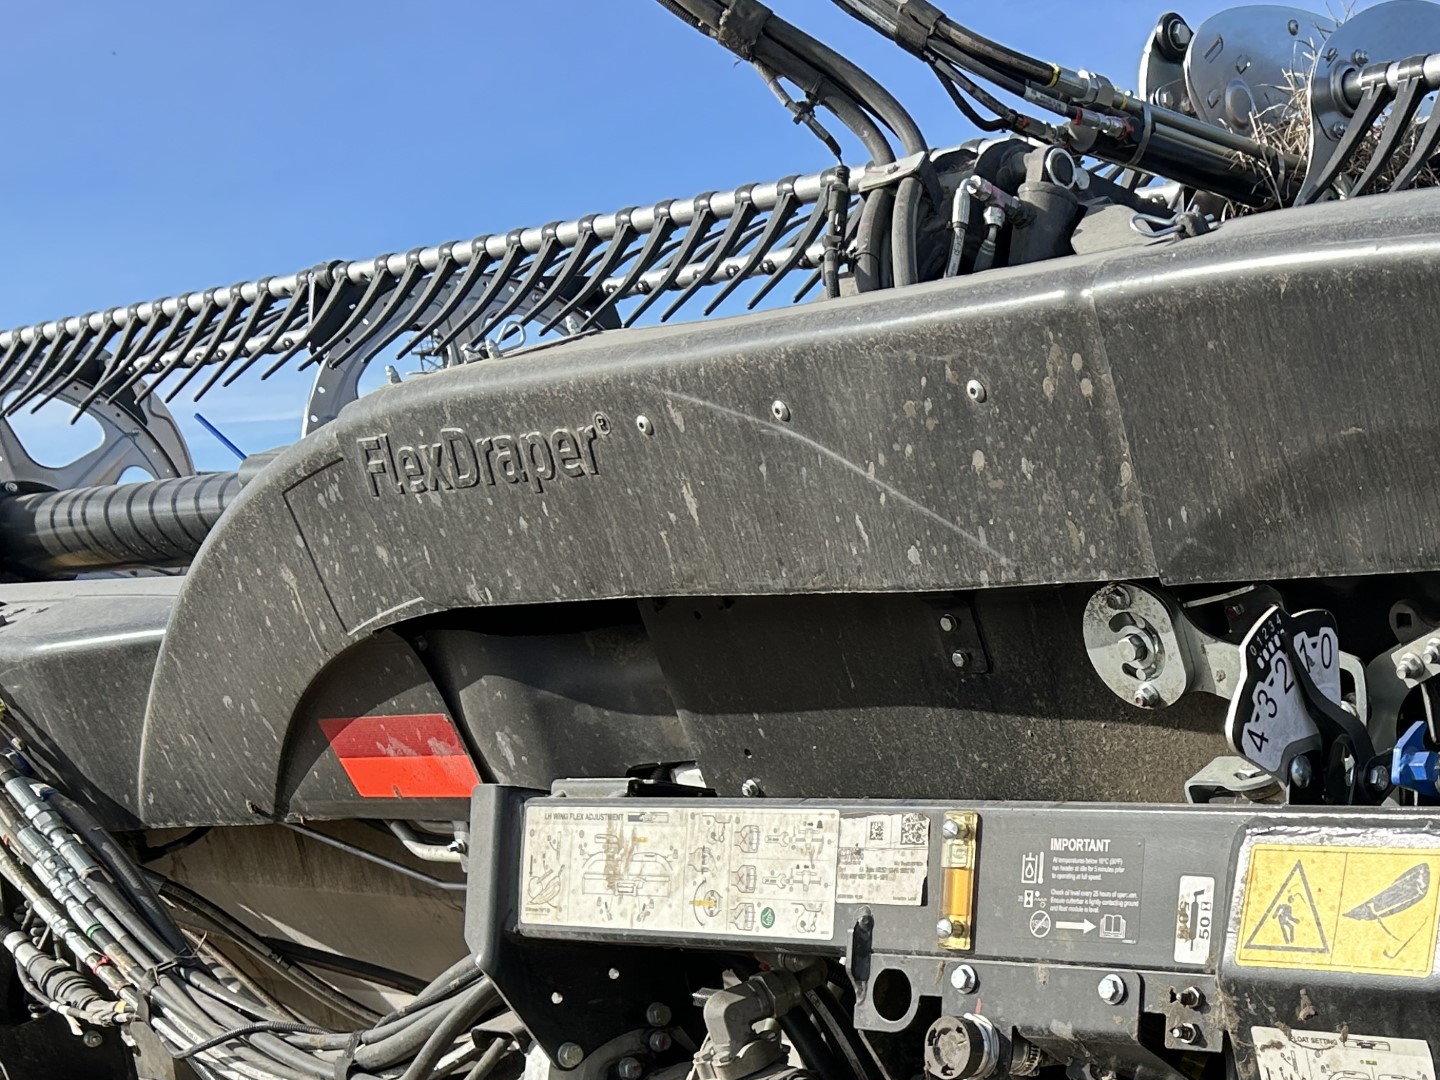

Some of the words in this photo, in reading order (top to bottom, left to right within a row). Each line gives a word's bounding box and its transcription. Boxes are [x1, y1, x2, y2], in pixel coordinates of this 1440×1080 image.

[1250, 645, 1257, 656] 0
[1262, 627, 1269, 640] 2
[1268, 620, 1275, 632] 3
[1321, 633, 1332, 669] 0
[1274, 657, 1295, 695] 2
[1257, 689, 1278, 719] 3
[1247, 728, 1269, 753] 4
[569, 813, 584, 821] FLEX
[585, 813, 624, 821] ADJUSTMENT
[1050, 838, 1111, 852] IMPORTANT
[1050, 888, 1064, 896] Check
[1198, 916, 1211, 940] 50
